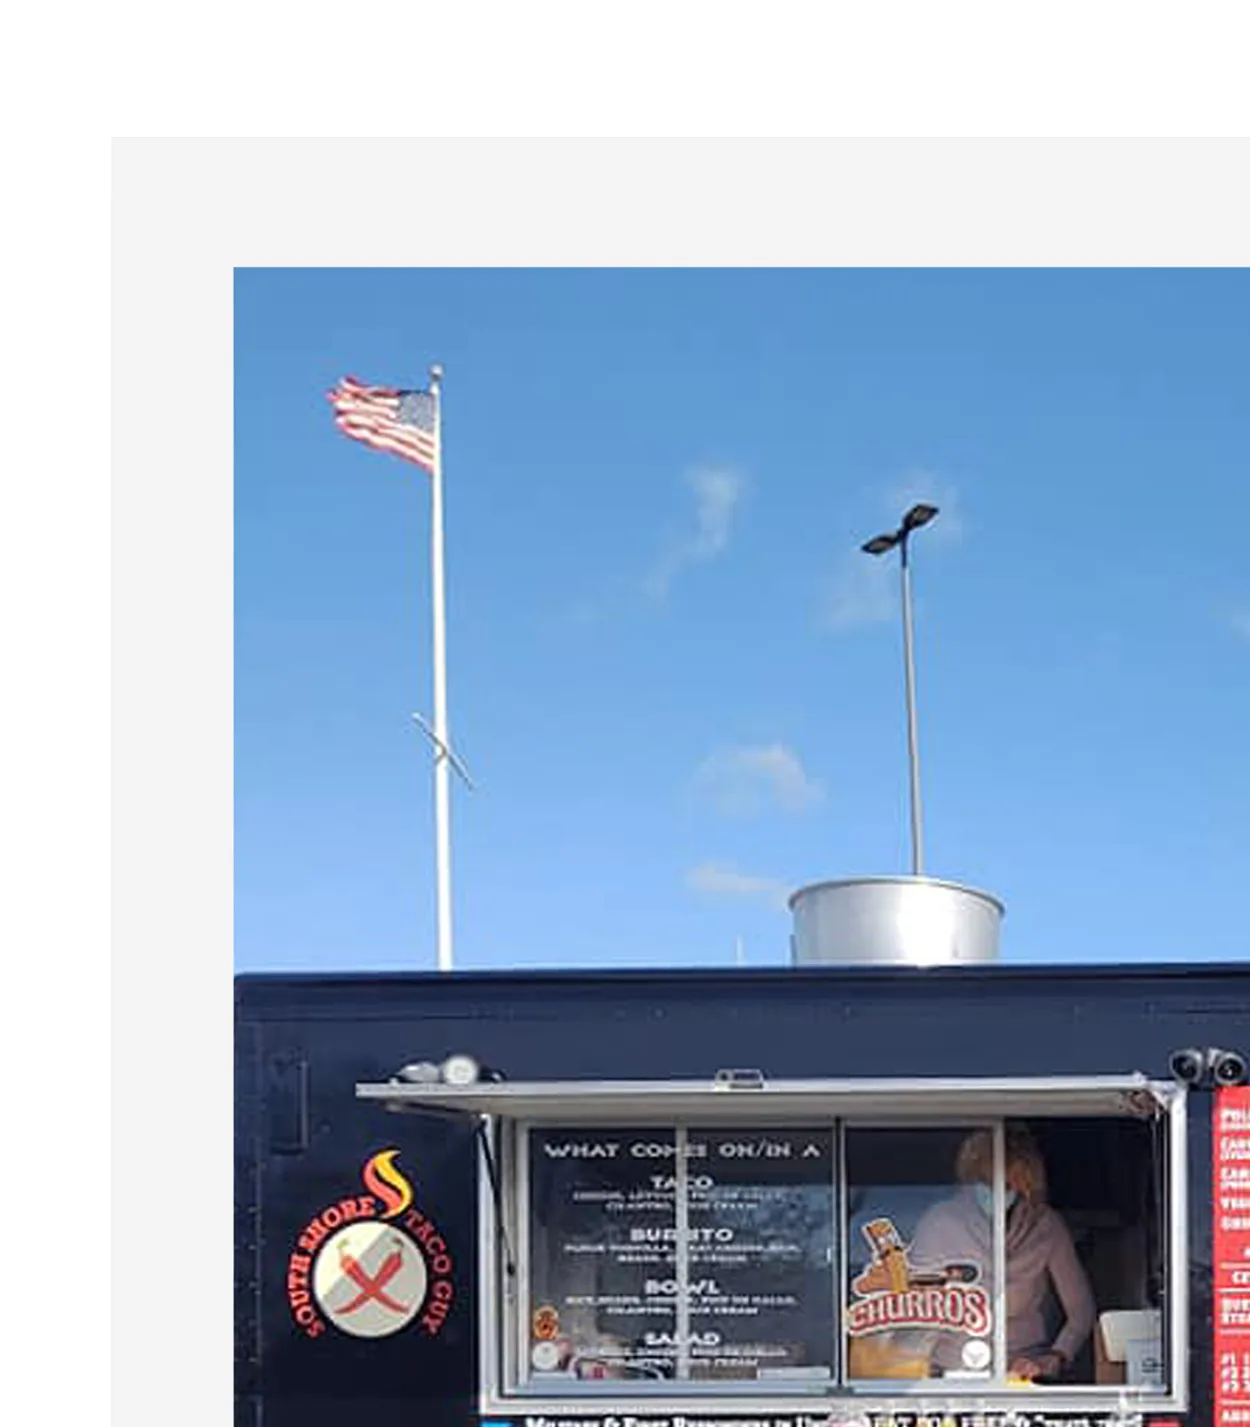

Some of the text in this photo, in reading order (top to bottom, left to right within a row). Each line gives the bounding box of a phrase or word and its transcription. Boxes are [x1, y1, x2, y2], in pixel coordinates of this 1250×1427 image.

[545, 1143, 620, 1157] WHAT
[803, 1144, 821, 1157] A
[631, 1228, 734, 1242] BURITO
[287, 1197, 454, 1337] SOUTH SHORE TACO GUY
[848, 1286, 991, 1336] CHURROS
